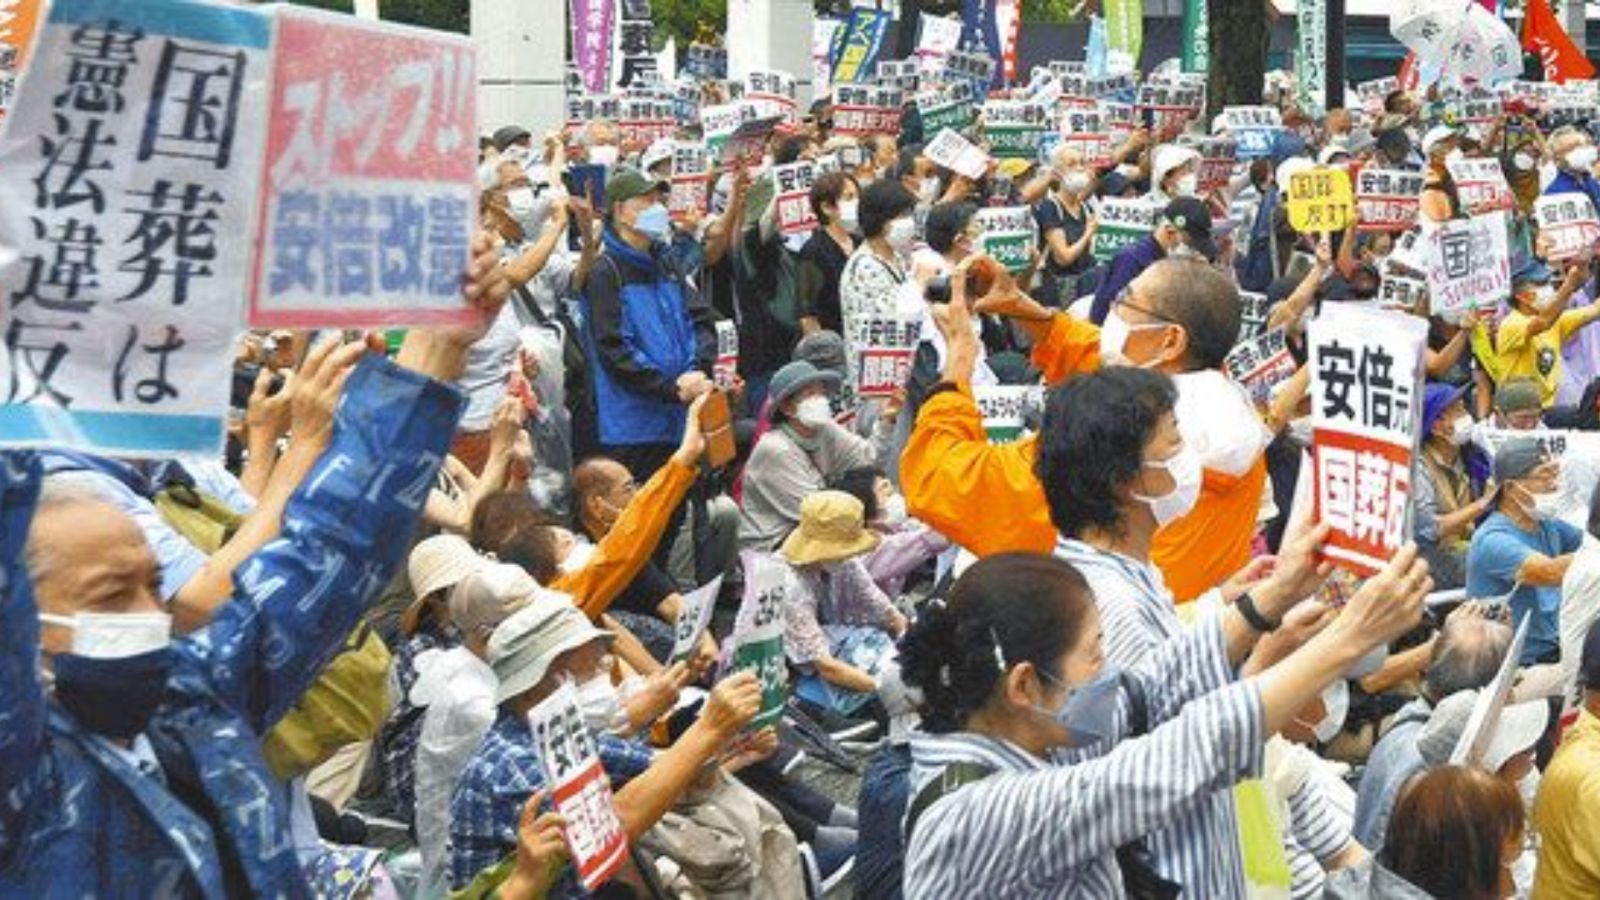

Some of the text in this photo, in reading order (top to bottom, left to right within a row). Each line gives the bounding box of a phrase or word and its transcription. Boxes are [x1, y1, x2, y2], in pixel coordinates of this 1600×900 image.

[0, 17, 145, 409] 憲法違反
[112, 38, 248, 405] 国葬は
